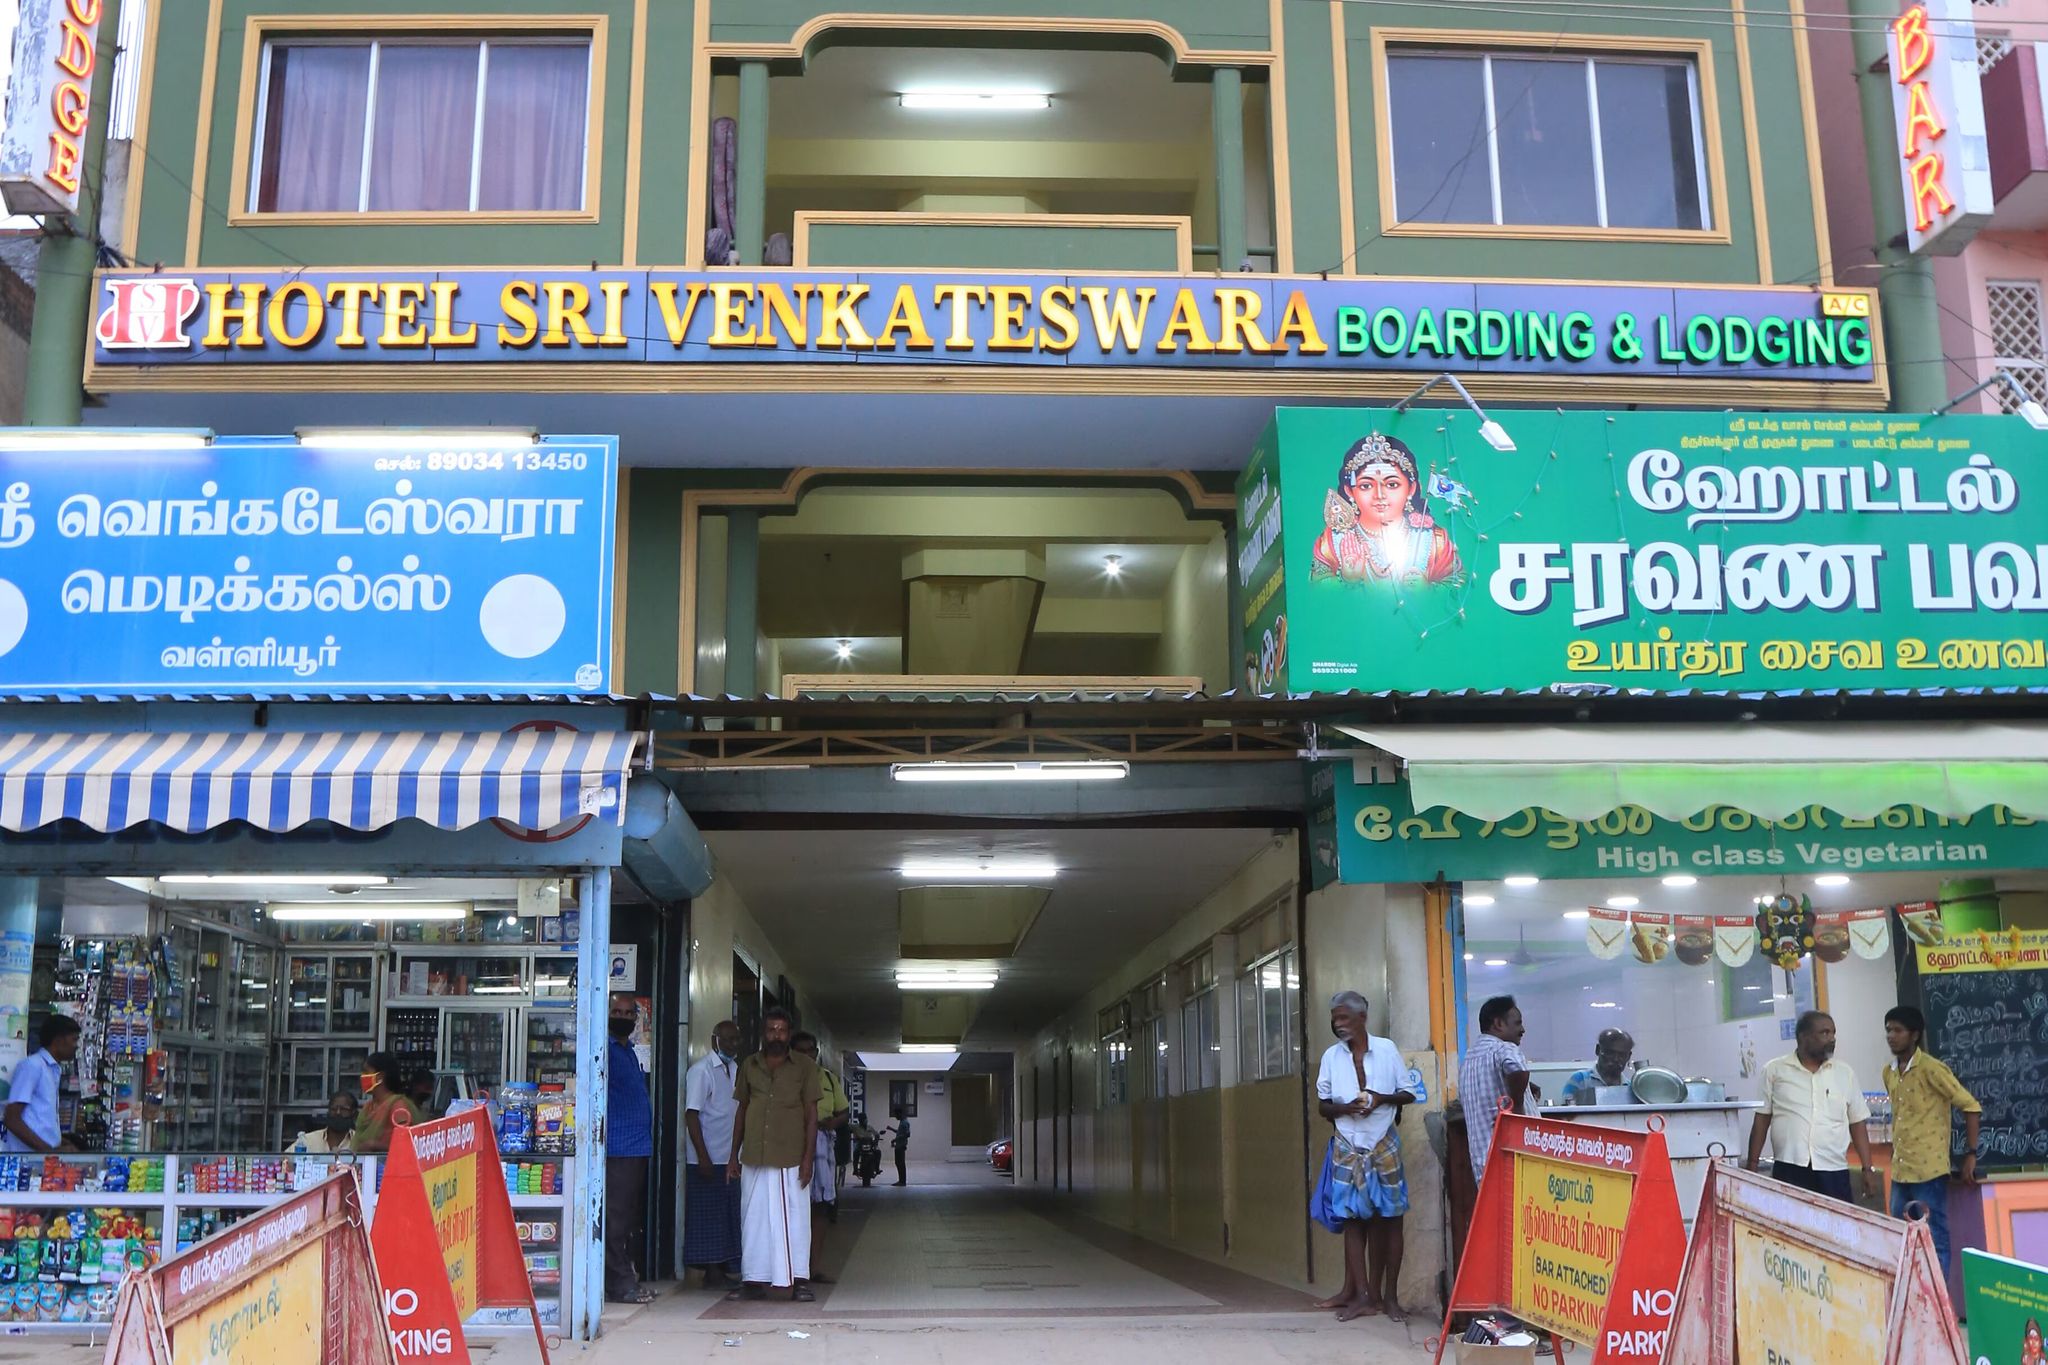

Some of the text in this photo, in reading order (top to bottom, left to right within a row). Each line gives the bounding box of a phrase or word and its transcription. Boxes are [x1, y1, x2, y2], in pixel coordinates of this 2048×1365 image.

[1894, 6, 1956, 232] BAR
[202, 280, 1329, 354] HOTEL SRI VENKATESWARA
[1828, 296, 1867, 312] A/C
[1337, 305, 1873, 367] BOARDING & LODGING
[426, 452, 504, 470] 89034
[512, 451, 588, 470] 13450
[57, 479, 584, 543] வெங்கடேஸ்வரா
[1627, 449, 2018, 530] ஹோட்டல்
[61, 554, 452, 623] மெடிக்கல்ஸ்
[1489, 541, 1886, 630] சரவண
[160, 635, 341, 677] வள்ளியூர்
[1566, 627, 1748, 681] உயர்தர
[1759, 637, 1884, 672] சைவ
[1597, 840, 1988, 872] High class Vegetarian
[1576, 1135, 1605, 1158] காவல்
[1605, 1142, 1633, 1169] துறை
[1548, 1173, 1594, 1204] ஹோட்டல்
[1533, 1283, 1549, 1312] NO
[1631, 1289, 1675, 1317] NO
